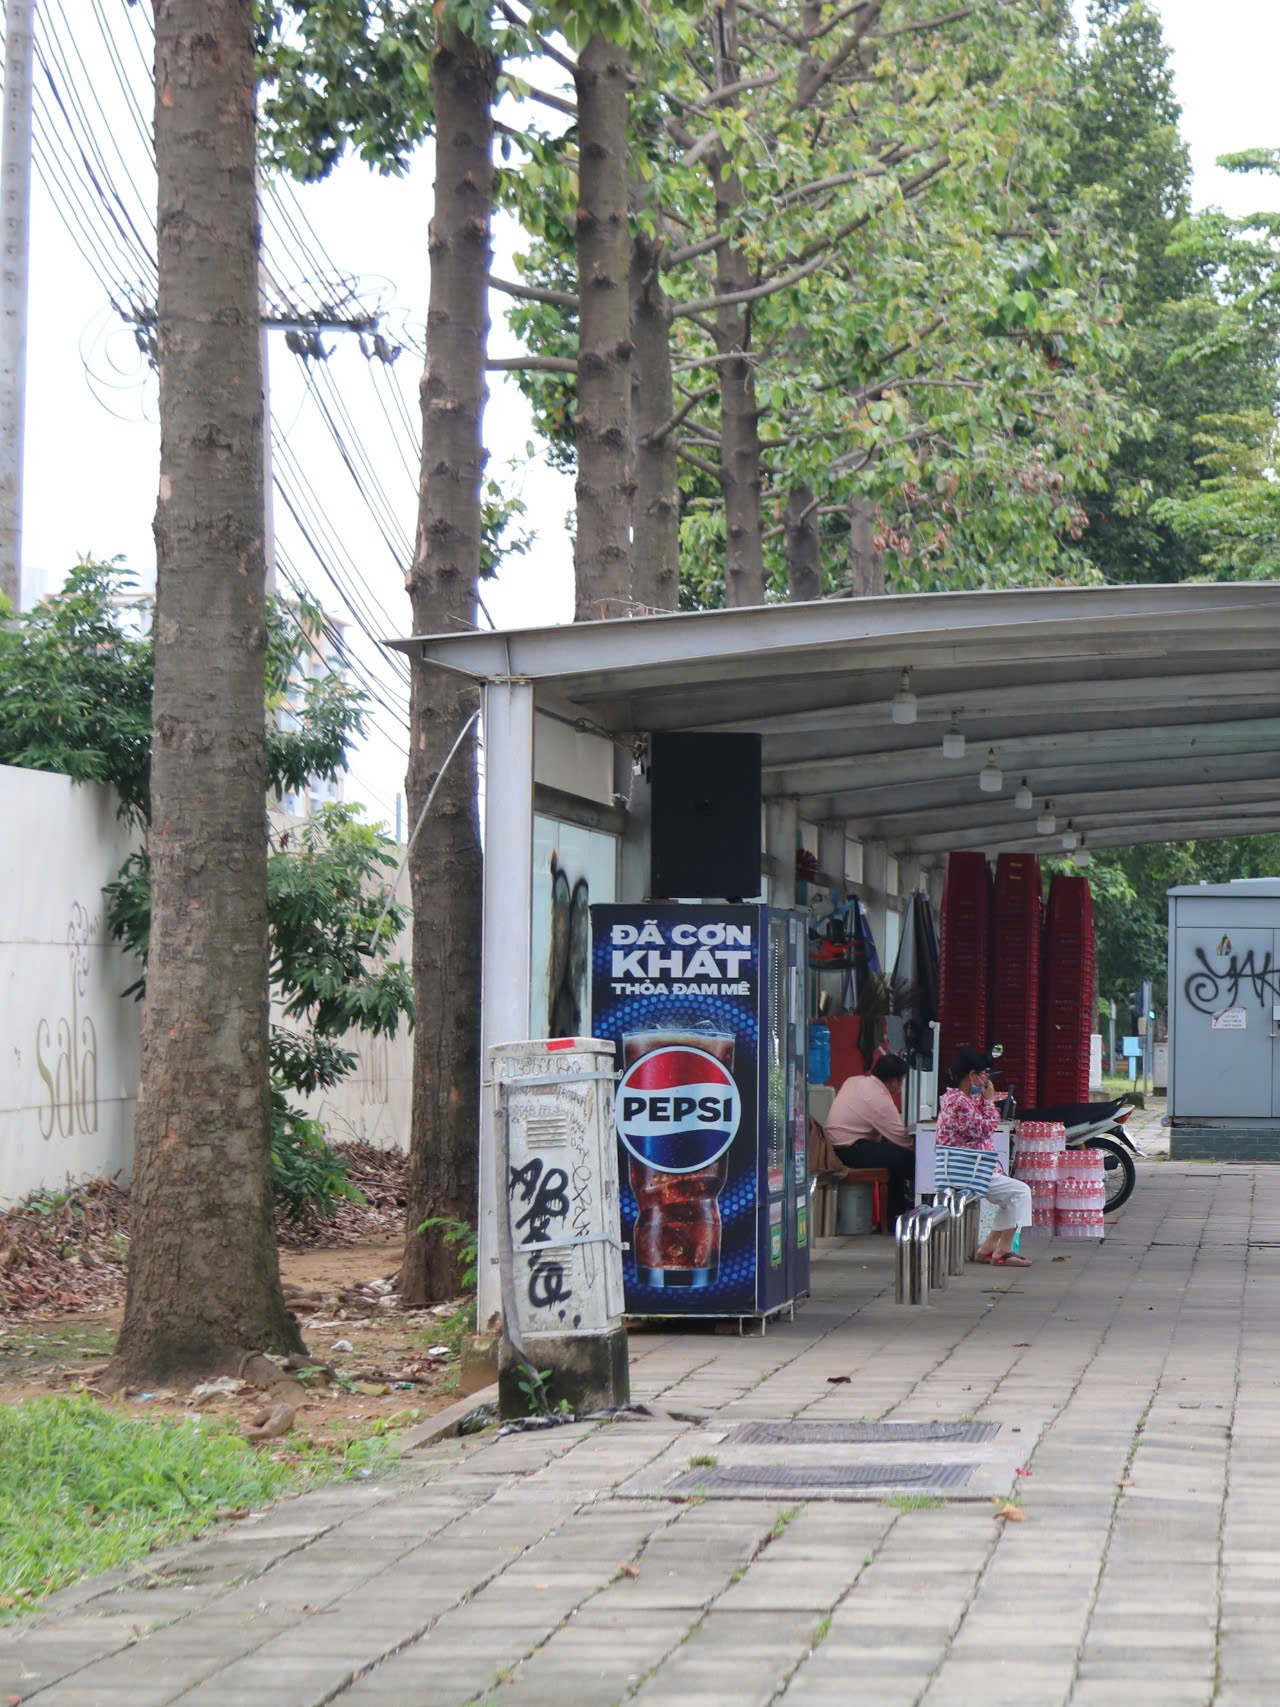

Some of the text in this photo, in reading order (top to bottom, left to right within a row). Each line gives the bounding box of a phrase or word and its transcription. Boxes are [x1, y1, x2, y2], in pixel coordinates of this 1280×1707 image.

[610, 919, 751, 946] ĐÃ CƠN
[611, 945, 751, 978] KHÁT
[611, 979, 751, 996] THỎA ĐAM MÊ
[623, 1096, 733, 1122] PEPSI
